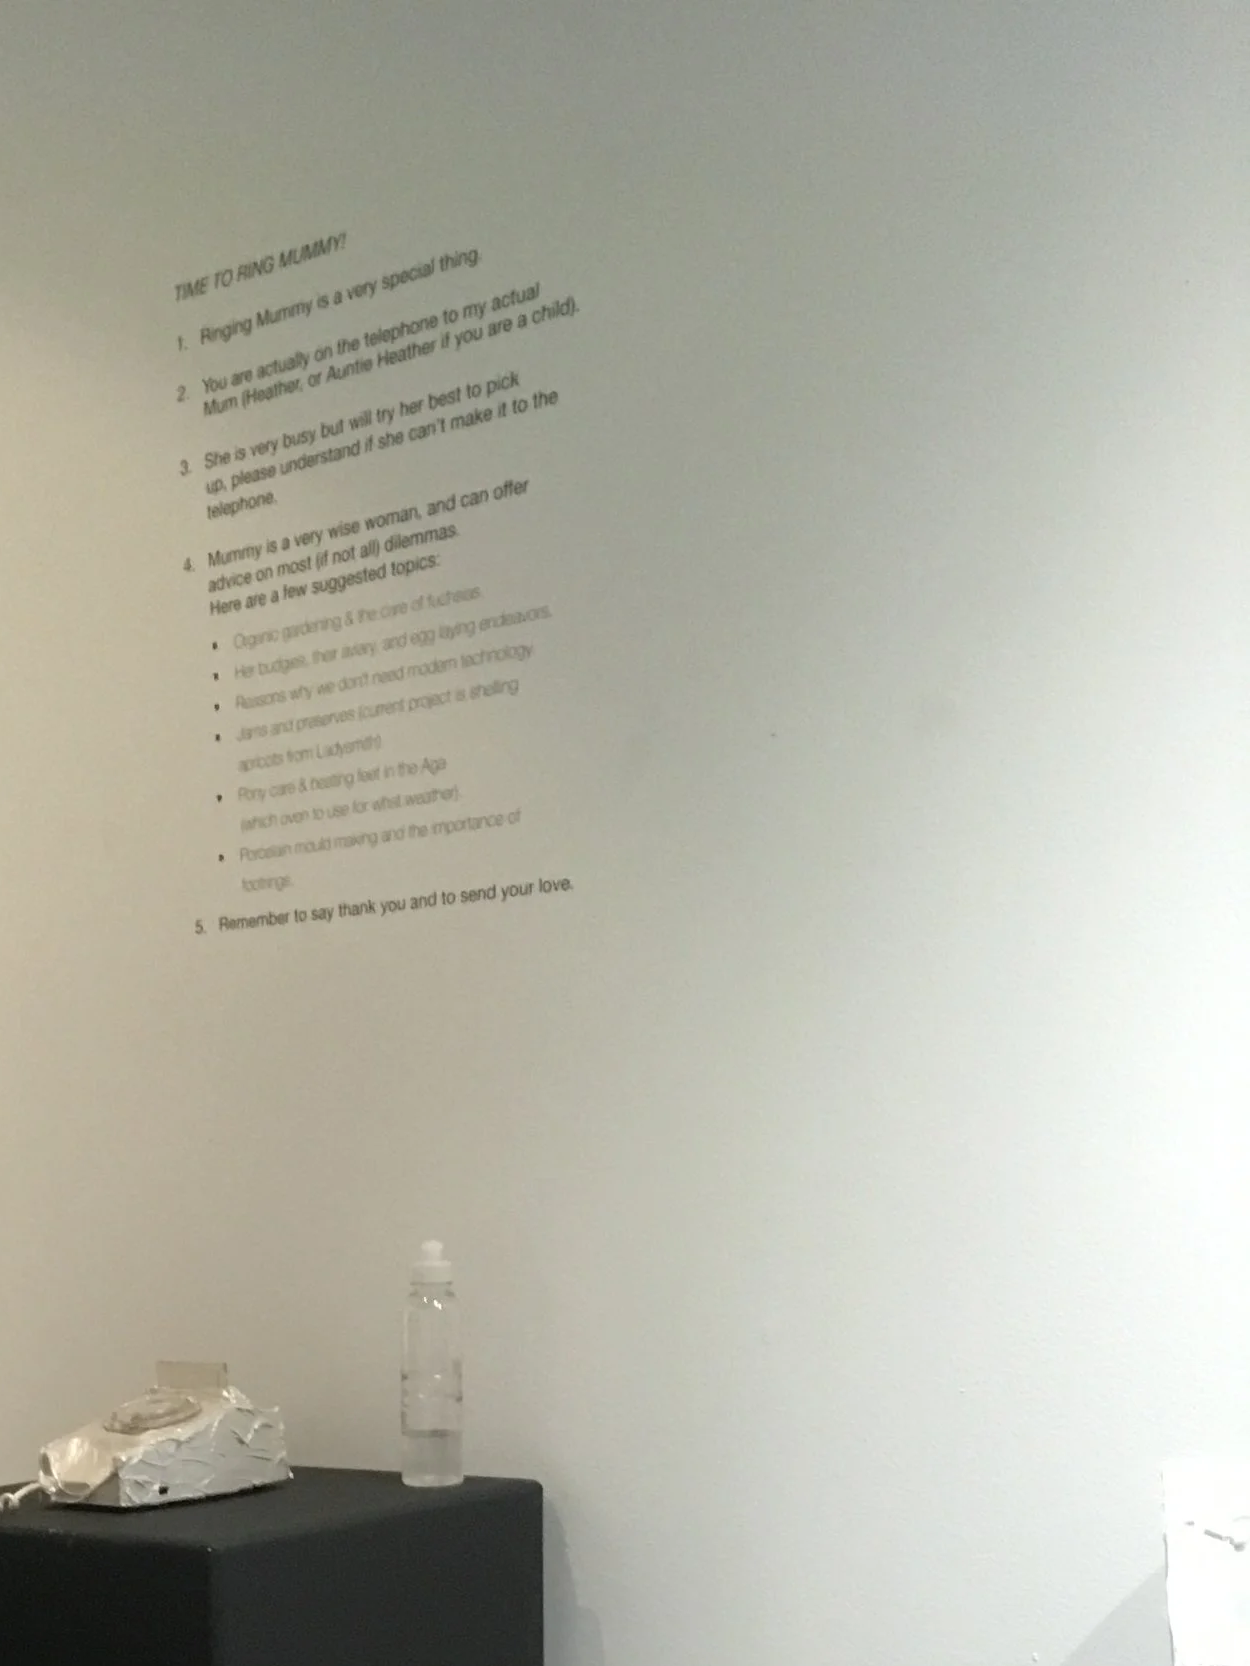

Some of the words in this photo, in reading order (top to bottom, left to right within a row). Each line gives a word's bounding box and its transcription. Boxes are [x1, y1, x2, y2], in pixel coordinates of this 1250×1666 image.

[174, 276, 209, 302] TIME
[214, 269, 233, 289] TO
[237, 256, 275, 282] RING
[279, 232, 347, 268] MUMMY!
[200, 318, 252, 345] Ringing
[256, 300, 313, 327] Mummy
[316, 293, 330, 309] is
[333, 290, 343, 305] a
[346, 280, 378, 300] very
[382, 256, 435, 291] special
[202, 377, 228, 394] You
[231, 369, 253, 387] are
[257, 351, 310, 380] actually
[314, 346, 333, 362] on
[337, 337, 361, 356] the
[364, 315, 439, 347] telephone
[442, 308, 459, 325] to
[462, 301, 487, 320] my
[491, 280, 540, 312] actual
[203, 396, 238, 417] Mum
[307, 371, 323, 388] or
[326, 358, 373, 383] Auntie
[377, 339, 437, 368] Heather
[441, 331, 450, 349] if
[454, 327, 483, 351] you
[488, 318, 513, 337] are
[517, 313, 527, 329] a
[180, 459, 192, 477] 3.
[204, 451, 231, 469] She
[234, 445, 246, 461] is
[250, 439, 278, 456] very
[282, 429, 316, 449] busy
[320, 418, 344, 439] but
[348, 408, 372, 430] will
[376, 407, 394, 425] try
[399, 399, 423, 417] her
[428, 386, 461, 410] best
[466, 383, 482, 399] to
[486, 370, 520, 398] pick
[231, 465, 277, 492] please
[279, 439, 360, 475] understand
[364, 434, 374, 453] if
[377, 430, 404, 450] she
[408, 417, 446, 442] can't
[450, 407, 493, 430] make
[498, 401, 507, 418] it
[512, 398, 529, 415] to
[532, 390, 559, 409] the
[207, 544, 262, 568] Mummy
[266, 538, 277, 554] is
[282, 537, 291, 551] a
[294, 529, 323, 547] very
[327, 520, 360, 539] wise
[426, 493, 456, 517] and
[460, 489, 489, 509] can
[493, 479, 530, 501] offer
[208, 572, 252, 593] advice
[256, 566, 273, 582] on
[277, 555, 312, 576] most
[316, 550, 329, 571] (if
[332, 545, 356, 565] not
[360, 538, 380, 559] all)
[210, 599, 242, 616] Here
[245, 592, 267, 609] are
[270, 590, 280, 604] a
[283, 583, 307, 600] few
[311, 563, 386, 595] suggested
[282, 616, 342, 643] gardening
[345, 609, 354, 626] &
[357, 608, 377, 624] the
[380, 602, 408, 619] care
[411, 595, 423, 611] of
[235, 664, 254, 680] Her
[382, 631, 407, 651] and
[410, 629, 435, 647] egg
[235, 690, 287, 710] Reasons
[290, 685, 312, 702] why
[317, 681, 335, 695] we
[372, 666, 404, 684] need
[407, 657, 458, 677] modern
[270, 719, 293, 736] and
[296, 709, 356, 733] preserves
[358, 698, 404, 720] (current
[408, 690, 451, 712] project
[454, 688, 466, 702] is
[238, 786, 267, 802] Pony
[269, 782, 296, 798] care
[298, 777, 307, 793] &
[384, 765, 395, 780] in
[397, 761, 419, 777] the
[422, 756, 448, 776] Aga
[286, 748, 313, 763] from
[280, 810, 310, 826] oven
[312, 807, 324, 821] to
[326, 804, 350, 819] use
[352, 799, 369, 814] for
[372, 794, 401, 812] what
[294, 836, 332, 854] mould
[333, 832, 378, 849] making
[381, 823, 405, 843] and
[408, 823, 429, 839] the
[432, 814, 504, 835] importance
[508, 806, 522, 825] of
[194, 919, 207, 935] 5.
[218, 909, 290, 932] Remember
[294, 908, 307, 924] to
[311, 906, 334, 923] say
[338, 898, 377, 918] thank
[380, 898, 406, 917] you
[410, 891, 438, 911] and
[441, 891, 457, 906] to
[460, 884, 497, 904] send
[501, 882, 535, 902] your
[538, 877, 574, 894] love.
